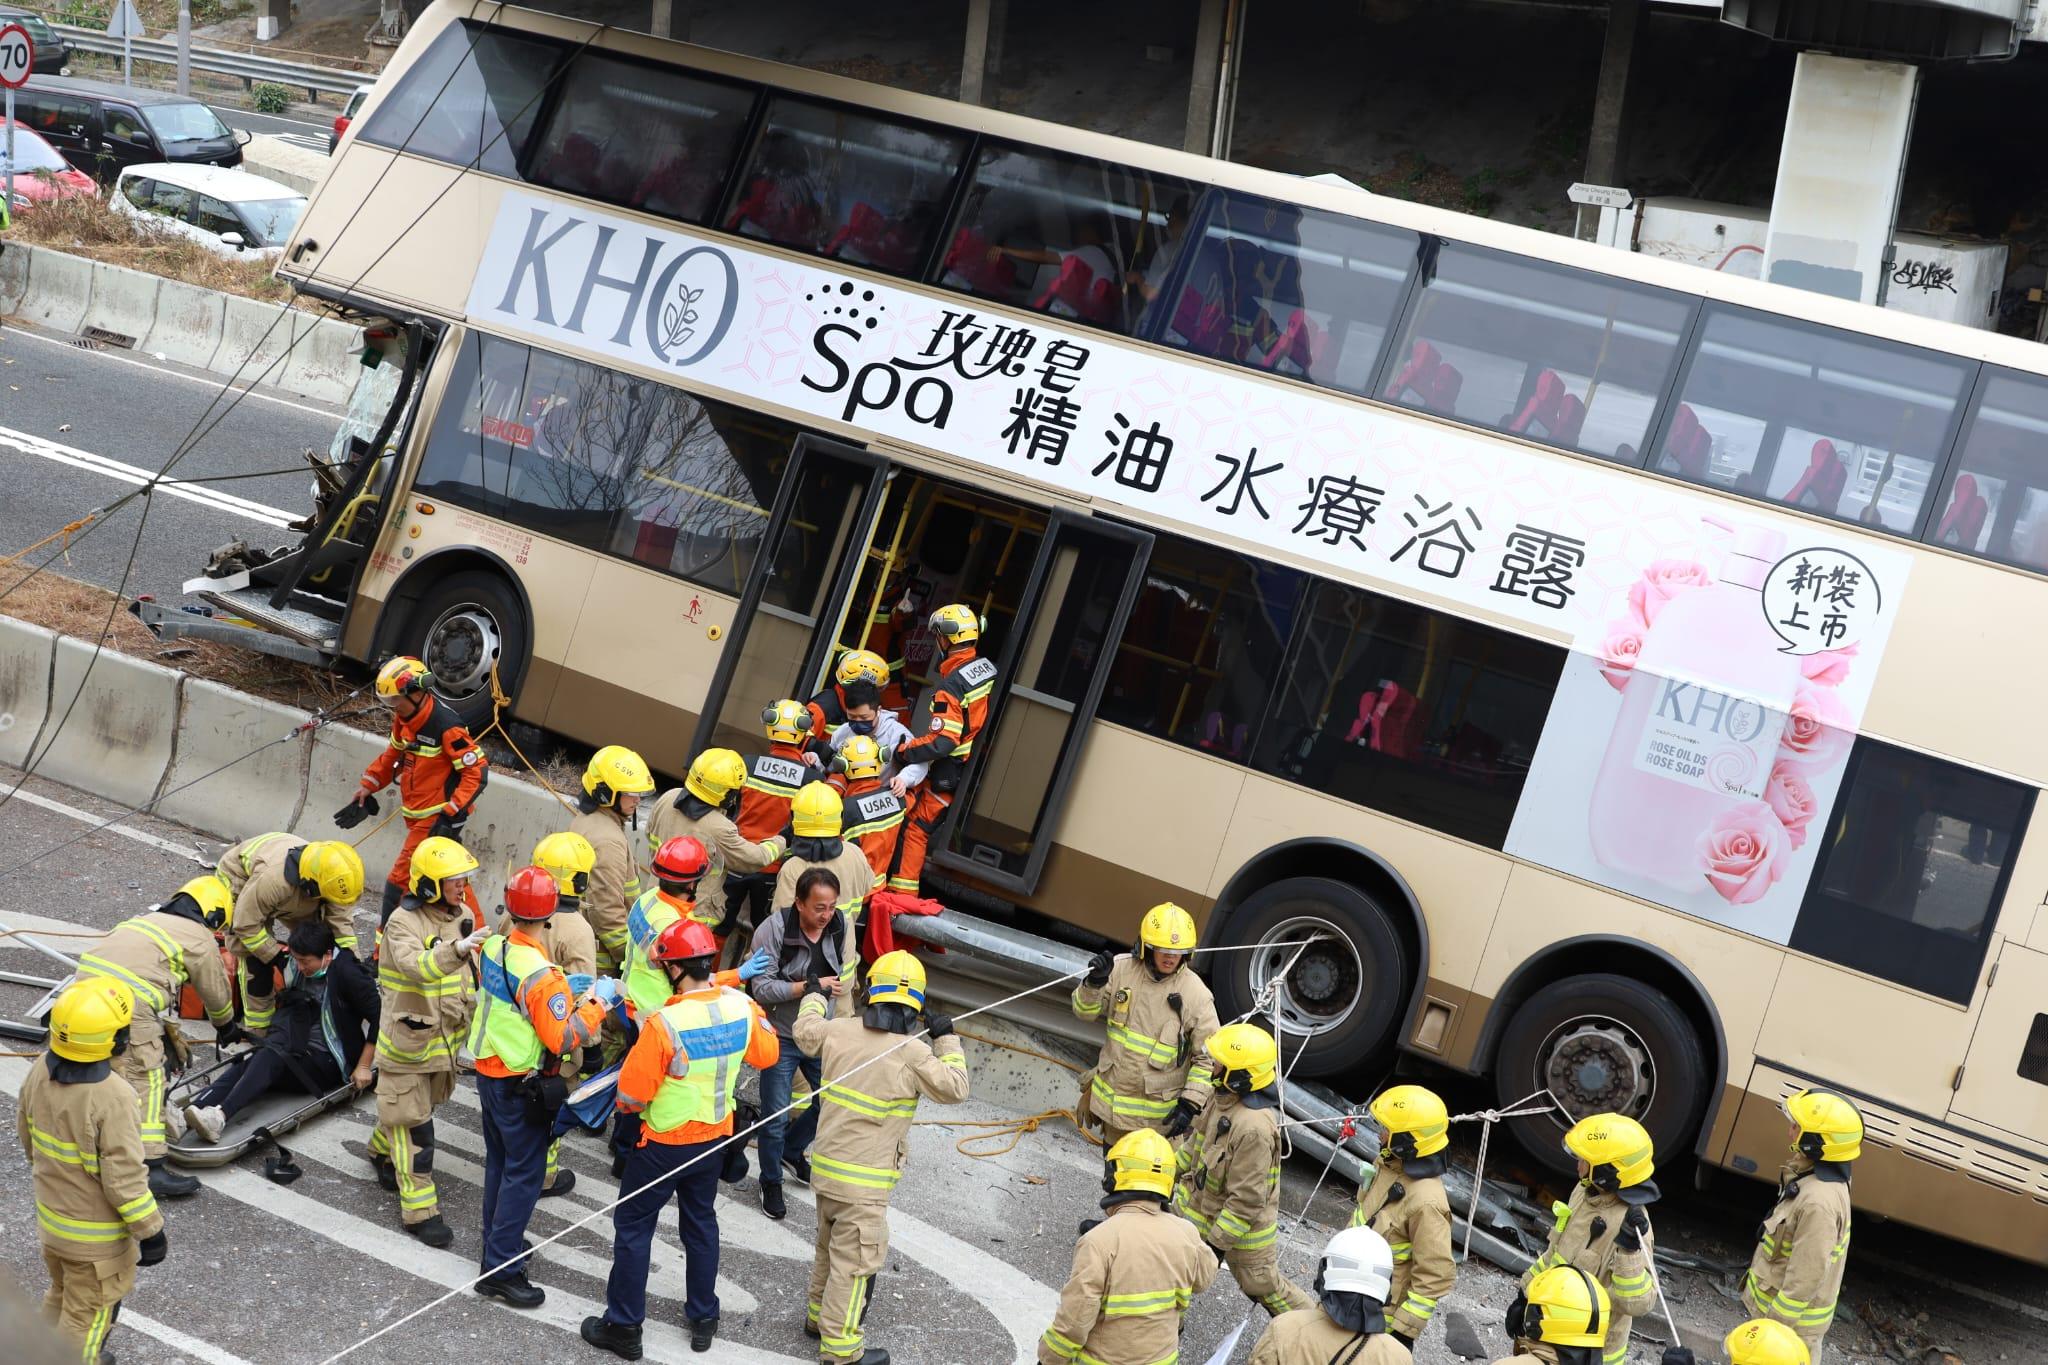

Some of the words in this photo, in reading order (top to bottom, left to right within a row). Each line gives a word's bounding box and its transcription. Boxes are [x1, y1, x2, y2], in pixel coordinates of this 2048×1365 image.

[1, 43, 28, 70] 70
[495, 207, 739, 366] KHO
[889, 310, 1091, 393] 玫瑰皂
[800, 323, 953, 430] Spa
[1001, 387, 1585, 610] 精油水療浴露
[515, 555, 528, 565] 138
[1787, 556, 1861, 609] 新裝
[1779, 602, 1848, 648] 上市
[965, 662, 993, 681] USAR
[1656, 678, 1766, 743] KHO
[1648, 740, 1676, 757] ROSE
[614, 762, 635, 778] CSW
[761, 761, 798, 780] USAR
[1646, 752, 1675, 770] ROSE
[1675, 761, 1705, 778] SOAP
[863, 796, 894, 814] USAR
[337, 878, 349, 895] CSW
[1230, 1043, 1242, 1051] KC
[1393, 1101, 1406, 1109] KC
[1587, 1132, 1608, 1141] CSW
